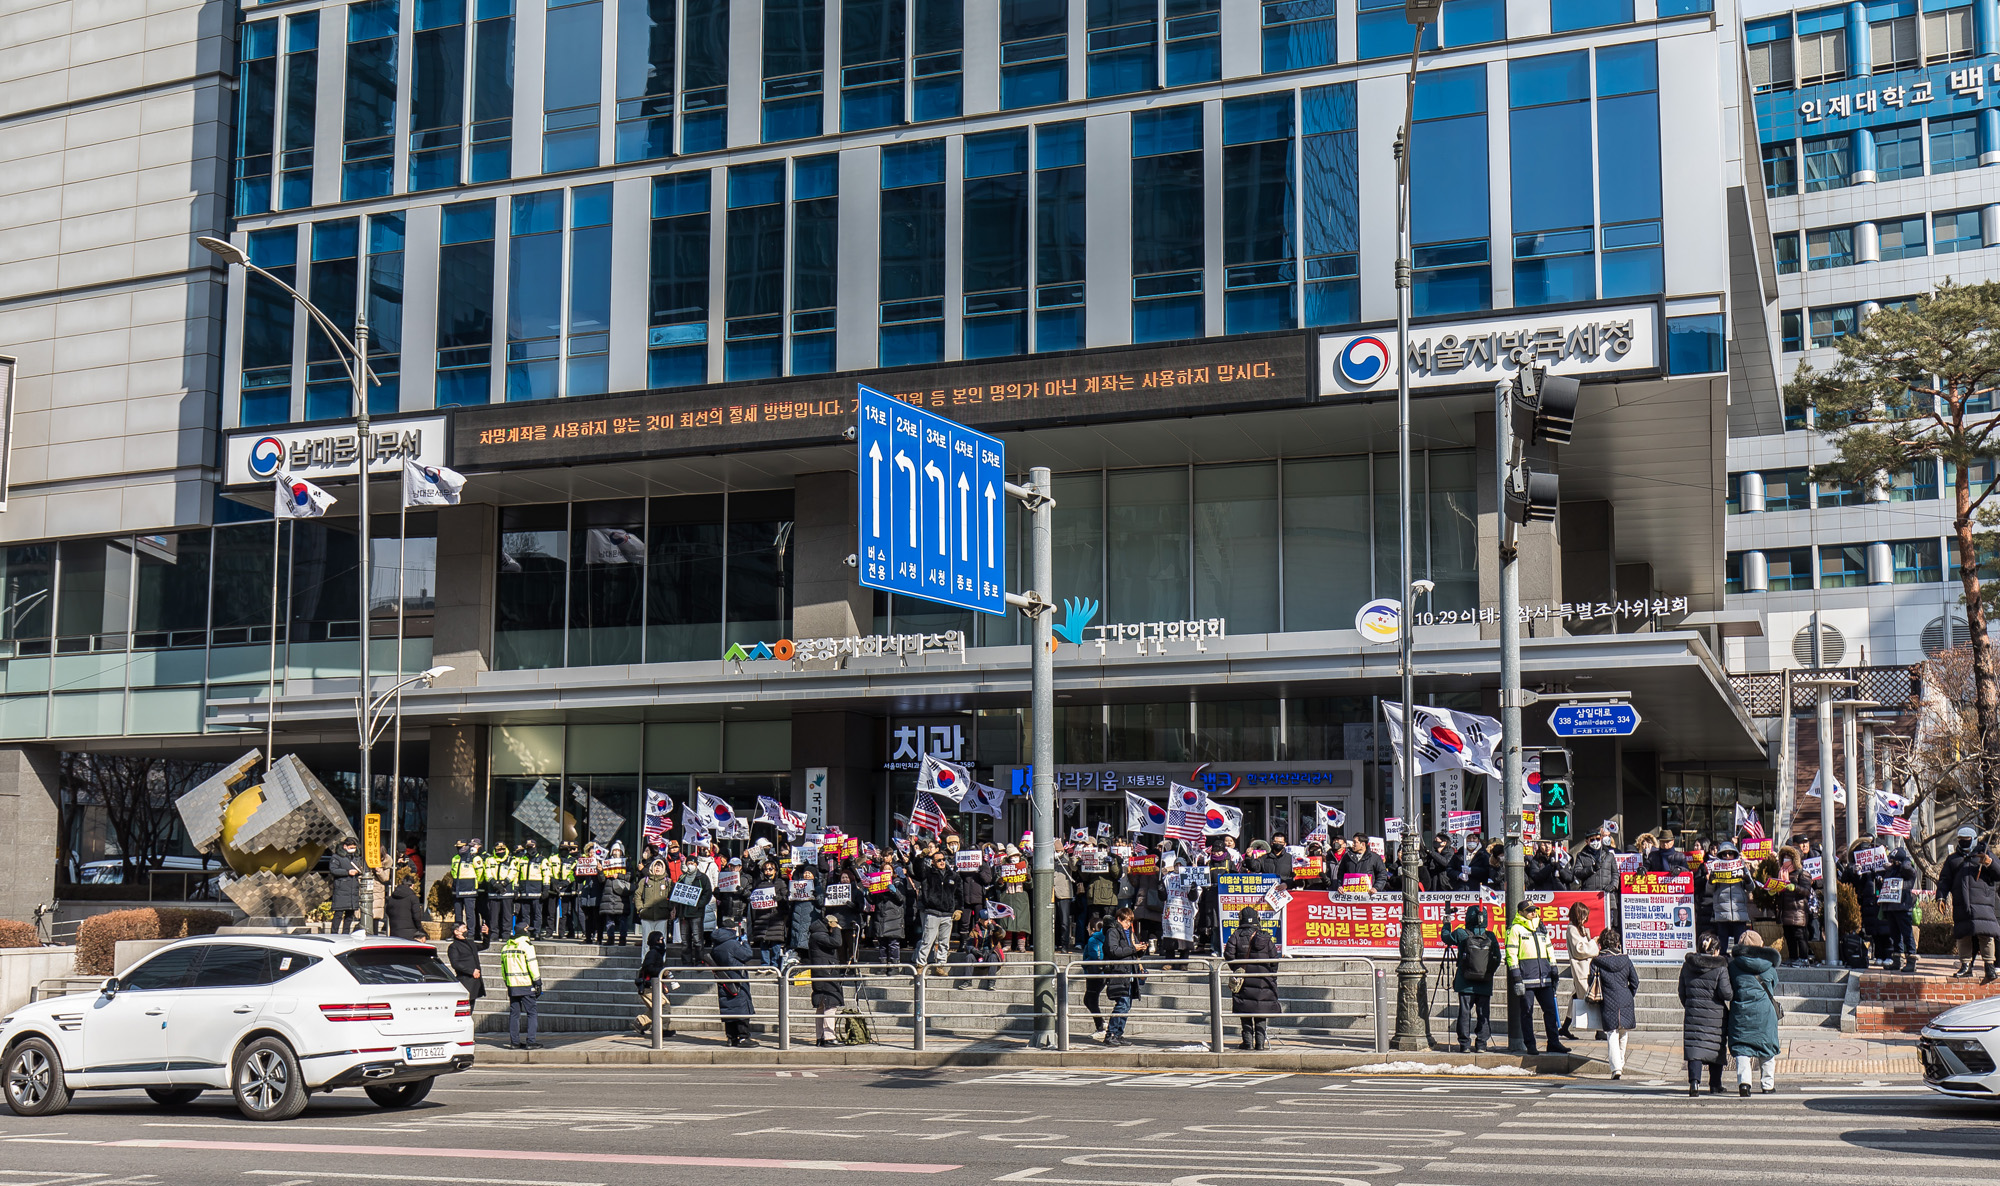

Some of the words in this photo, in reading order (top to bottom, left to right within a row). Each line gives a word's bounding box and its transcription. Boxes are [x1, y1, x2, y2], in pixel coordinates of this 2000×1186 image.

[1800, 80, 1935, 123] 인제대학교
[1407, 319, 1635, 371] 서울지방국세청
[479, 425, 547, 445] 차명계좌를
[552, 419, 608, 440] 사용하지
[612, 418, 642, 434] 않는
[646, 413, 675, 432] 것이
[680, 407, 724, 429] 최선의
[729, 403, 759, 425] 절세
[764, 399, 845, 422] 방법입니다.
[931, 389, 946, 407] 등
[952, 386, 984, 406] 본인
[990, 382, 1040, 403] 명의가
[1045, 379, 1078, 397] 아닌
[1084, 373, 1136, 393] 계좌는
[1142, 366, 1210, 390] 사용하지
[1218, 361, 1277, 381] 맙시다.
[864, 404, 887, 427] 1차로
[896, 416, 918, 439] 2차로
[290, 429, 422, 466] 남대문세무서
[926, 428, 947, 450] 3차로
[954, 439, 974, 459] 4차로
[981, 448, 1001, 469] 5차로
[412, 488, 454, 499] 남대문세무
[867, 545, 886, 563] 버스
[868, 562, 886, 581] 전용
[899, 561, 917, 580] 시청
[929, 568, 946, 587] 시청
[957, 573, 974, 593] 종로
[983, 581, 999, 599] 종로
[1414, 610, 1458, 627] 10·29
[1460, 604, 1552, 627] 이태참사
[1559, 595, 1690, 623] 특별조사위원회
[1094, 618, 1226, 653] 국가인권위원회
[796, 629, 966, 662] 중앙사회서비스원
[1558, 717, 1572, 726] 338
[1576, 707, 1614, 719] 삼일대로
[1617, 715, 1630, 725] 334
[1574, 719, 1615, 727] Samil-daero
[893, 724, 965, 761] 치과
[883, 761, 921, 771] 서울미인치과
[1126, 776, 1166, 788] 저동빌딩
[1200, 772, 1233, 788] 캠코
[1247, 772, 1335, 785] 한국자산관리공사
[811, 792, 823, 835] 국가인
[1552, 815, 1568, 835] 14
[675, 883, 701, 894] 부정선거
[793, 892, 811, 900] STEAL
[1227, 885, 1242, 894] 공격
[1632, 884, 1649, 894] 적극
[1651, 884, 1686, 895] 지지한다!
[1334, 893, 1353, 902] 인권은
[1419, 893, 1453, 903] 존중되어야
[1454, 894, 1471, 902] 한다!
[1307, 904, 1368, 921] 인권위는
[1371, 905, 1403, 921] 윤석
[1305, 921, 1351, 938] 방어권
[1354, 922, 1403, 939] 보장하
[429, 1047, 445, 1058] 6222
